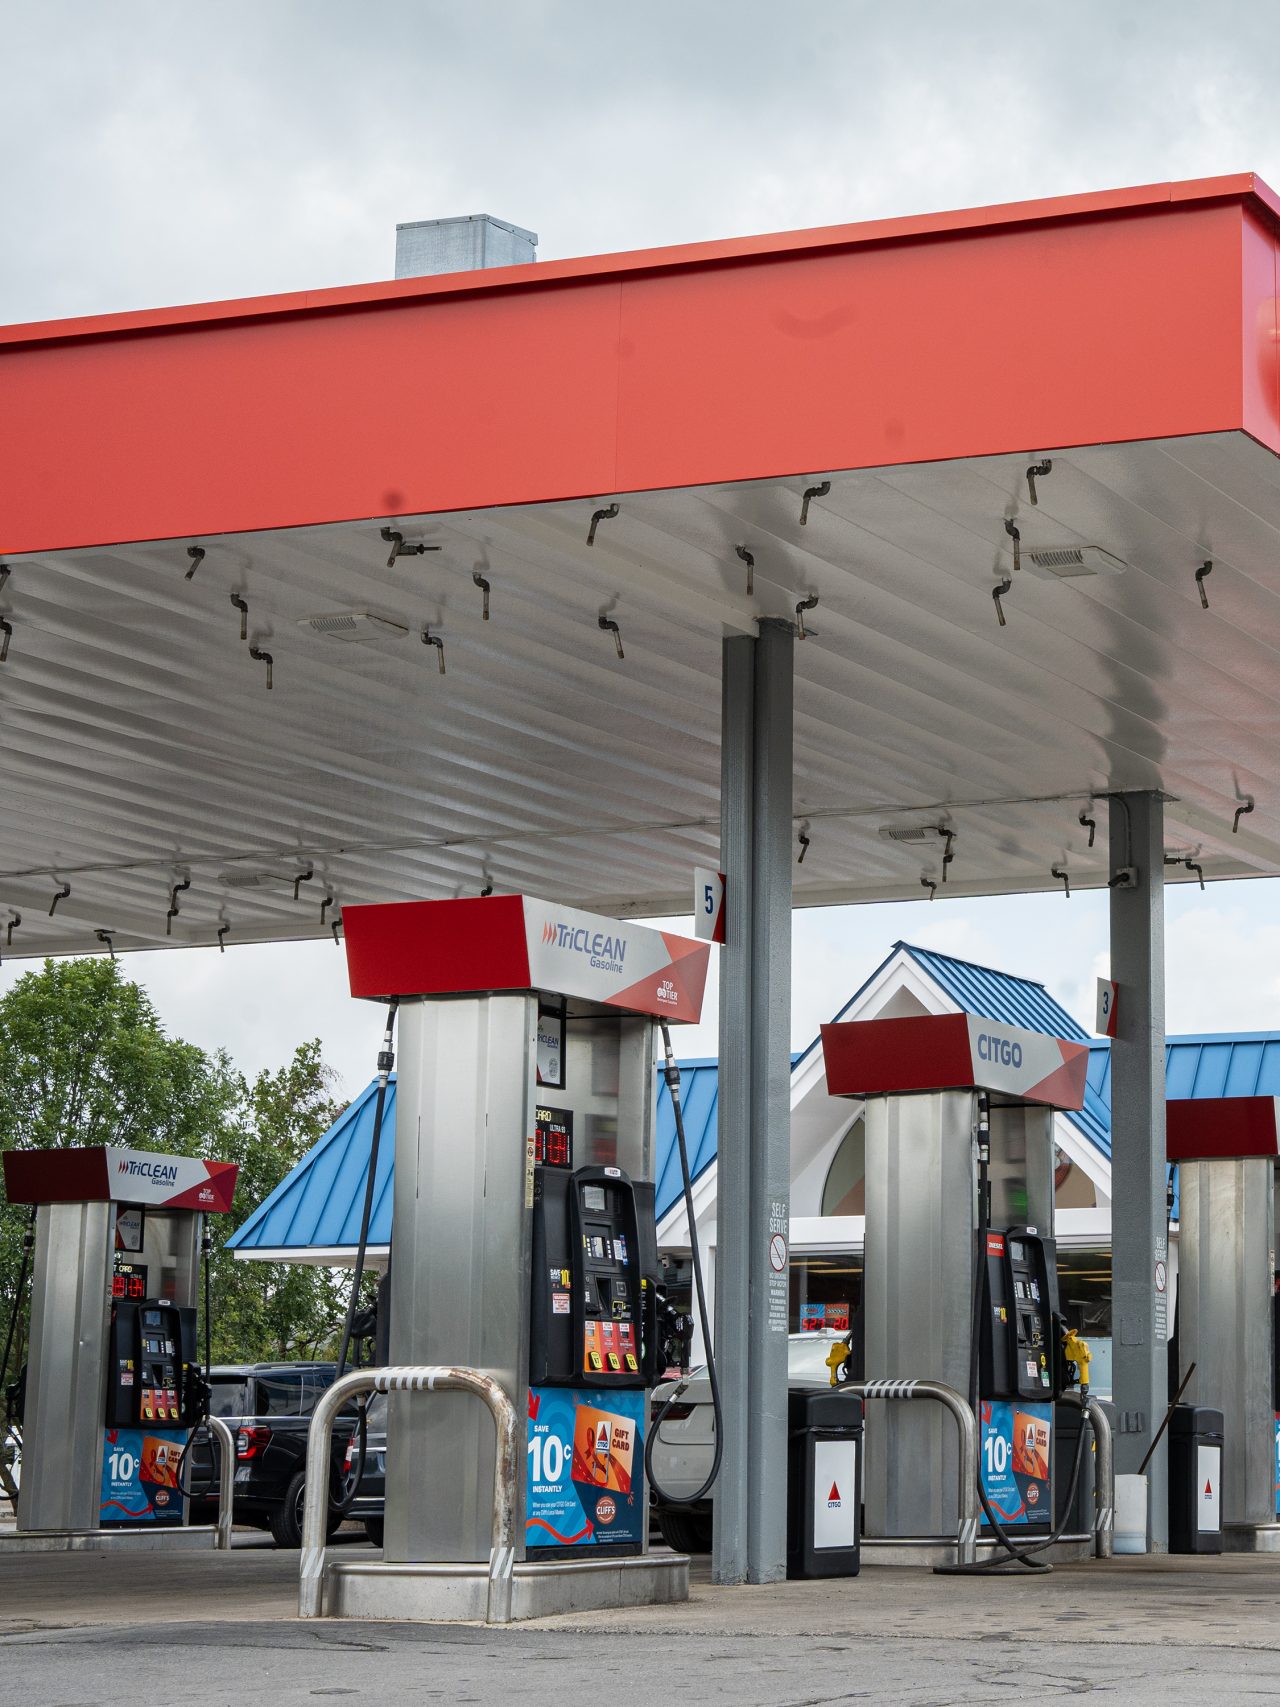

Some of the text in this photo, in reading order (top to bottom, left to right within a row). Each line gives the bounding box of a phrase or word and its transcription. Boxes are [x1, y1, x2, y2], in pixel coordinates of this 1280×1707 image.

[704, 885, 714, 915] 5
[557, 923, 627, 962] TriCLEAN
[590, 956, 624, 974] Gasoline
[662, 980, 673, 990] TOP
[666, 991, 678, 1001] TIER
[1102, 991, 1109, 1015] 3
[977, 1033, 1023, 1069] CITGO
[129, 1161, 178, 1180] TriCLEAN
[151, 1178, 175, 1187] Gasoline
[771, 1202, 786, 1217] SELF
[769, 1218, 788, 1234] SERVE
[534, 1425, 549, 1433] SAVE
[614, 1428, 630, 1440] GIFT
[1038, 1429, 1046, 1438] GIFT
[612, 1438, 630, 1452] CARD
[532, 1485, 563, 1493] INSTANTLY
